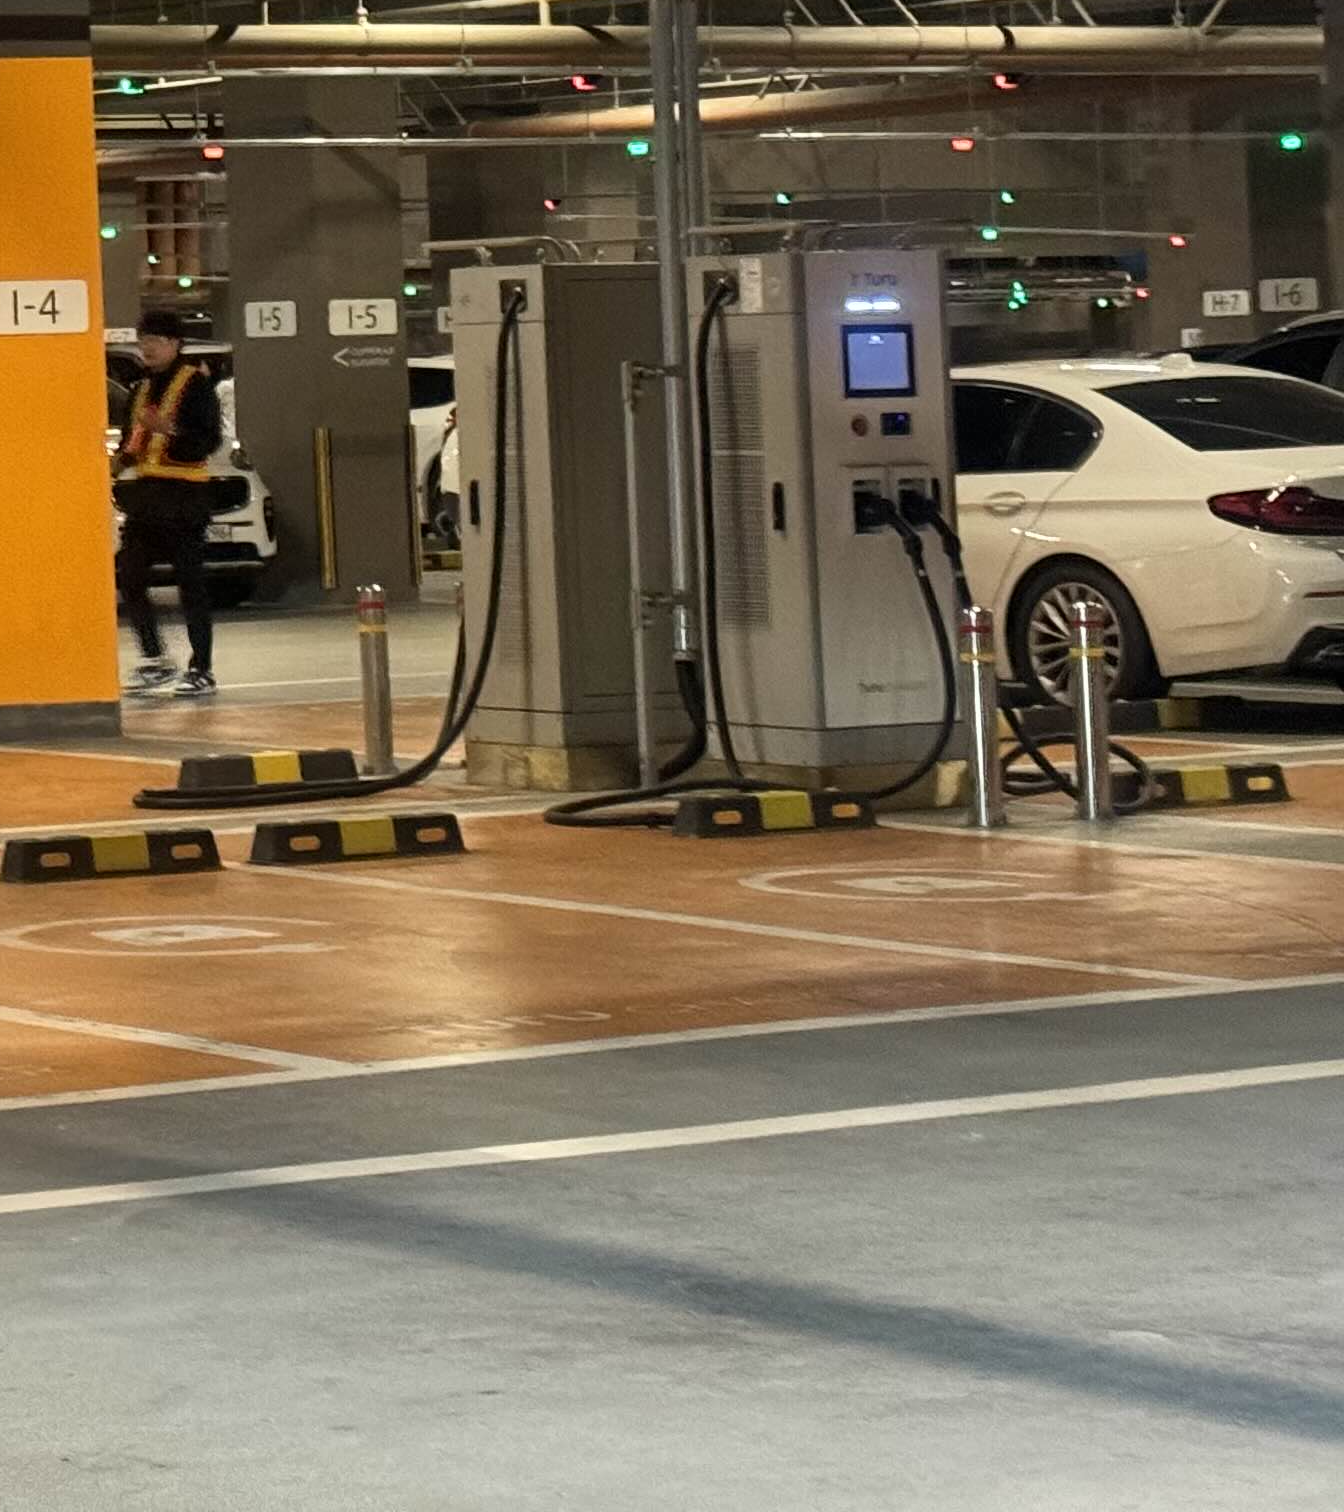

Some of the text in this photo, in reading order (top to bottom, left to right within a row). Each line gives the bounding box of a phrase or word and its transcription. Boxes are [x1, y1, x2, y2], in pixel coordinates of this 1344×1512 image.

[12, 289, 61, 326] I-4
[258, 306, 282, 332] I-5
[347, 304, 378, 330] I-5
